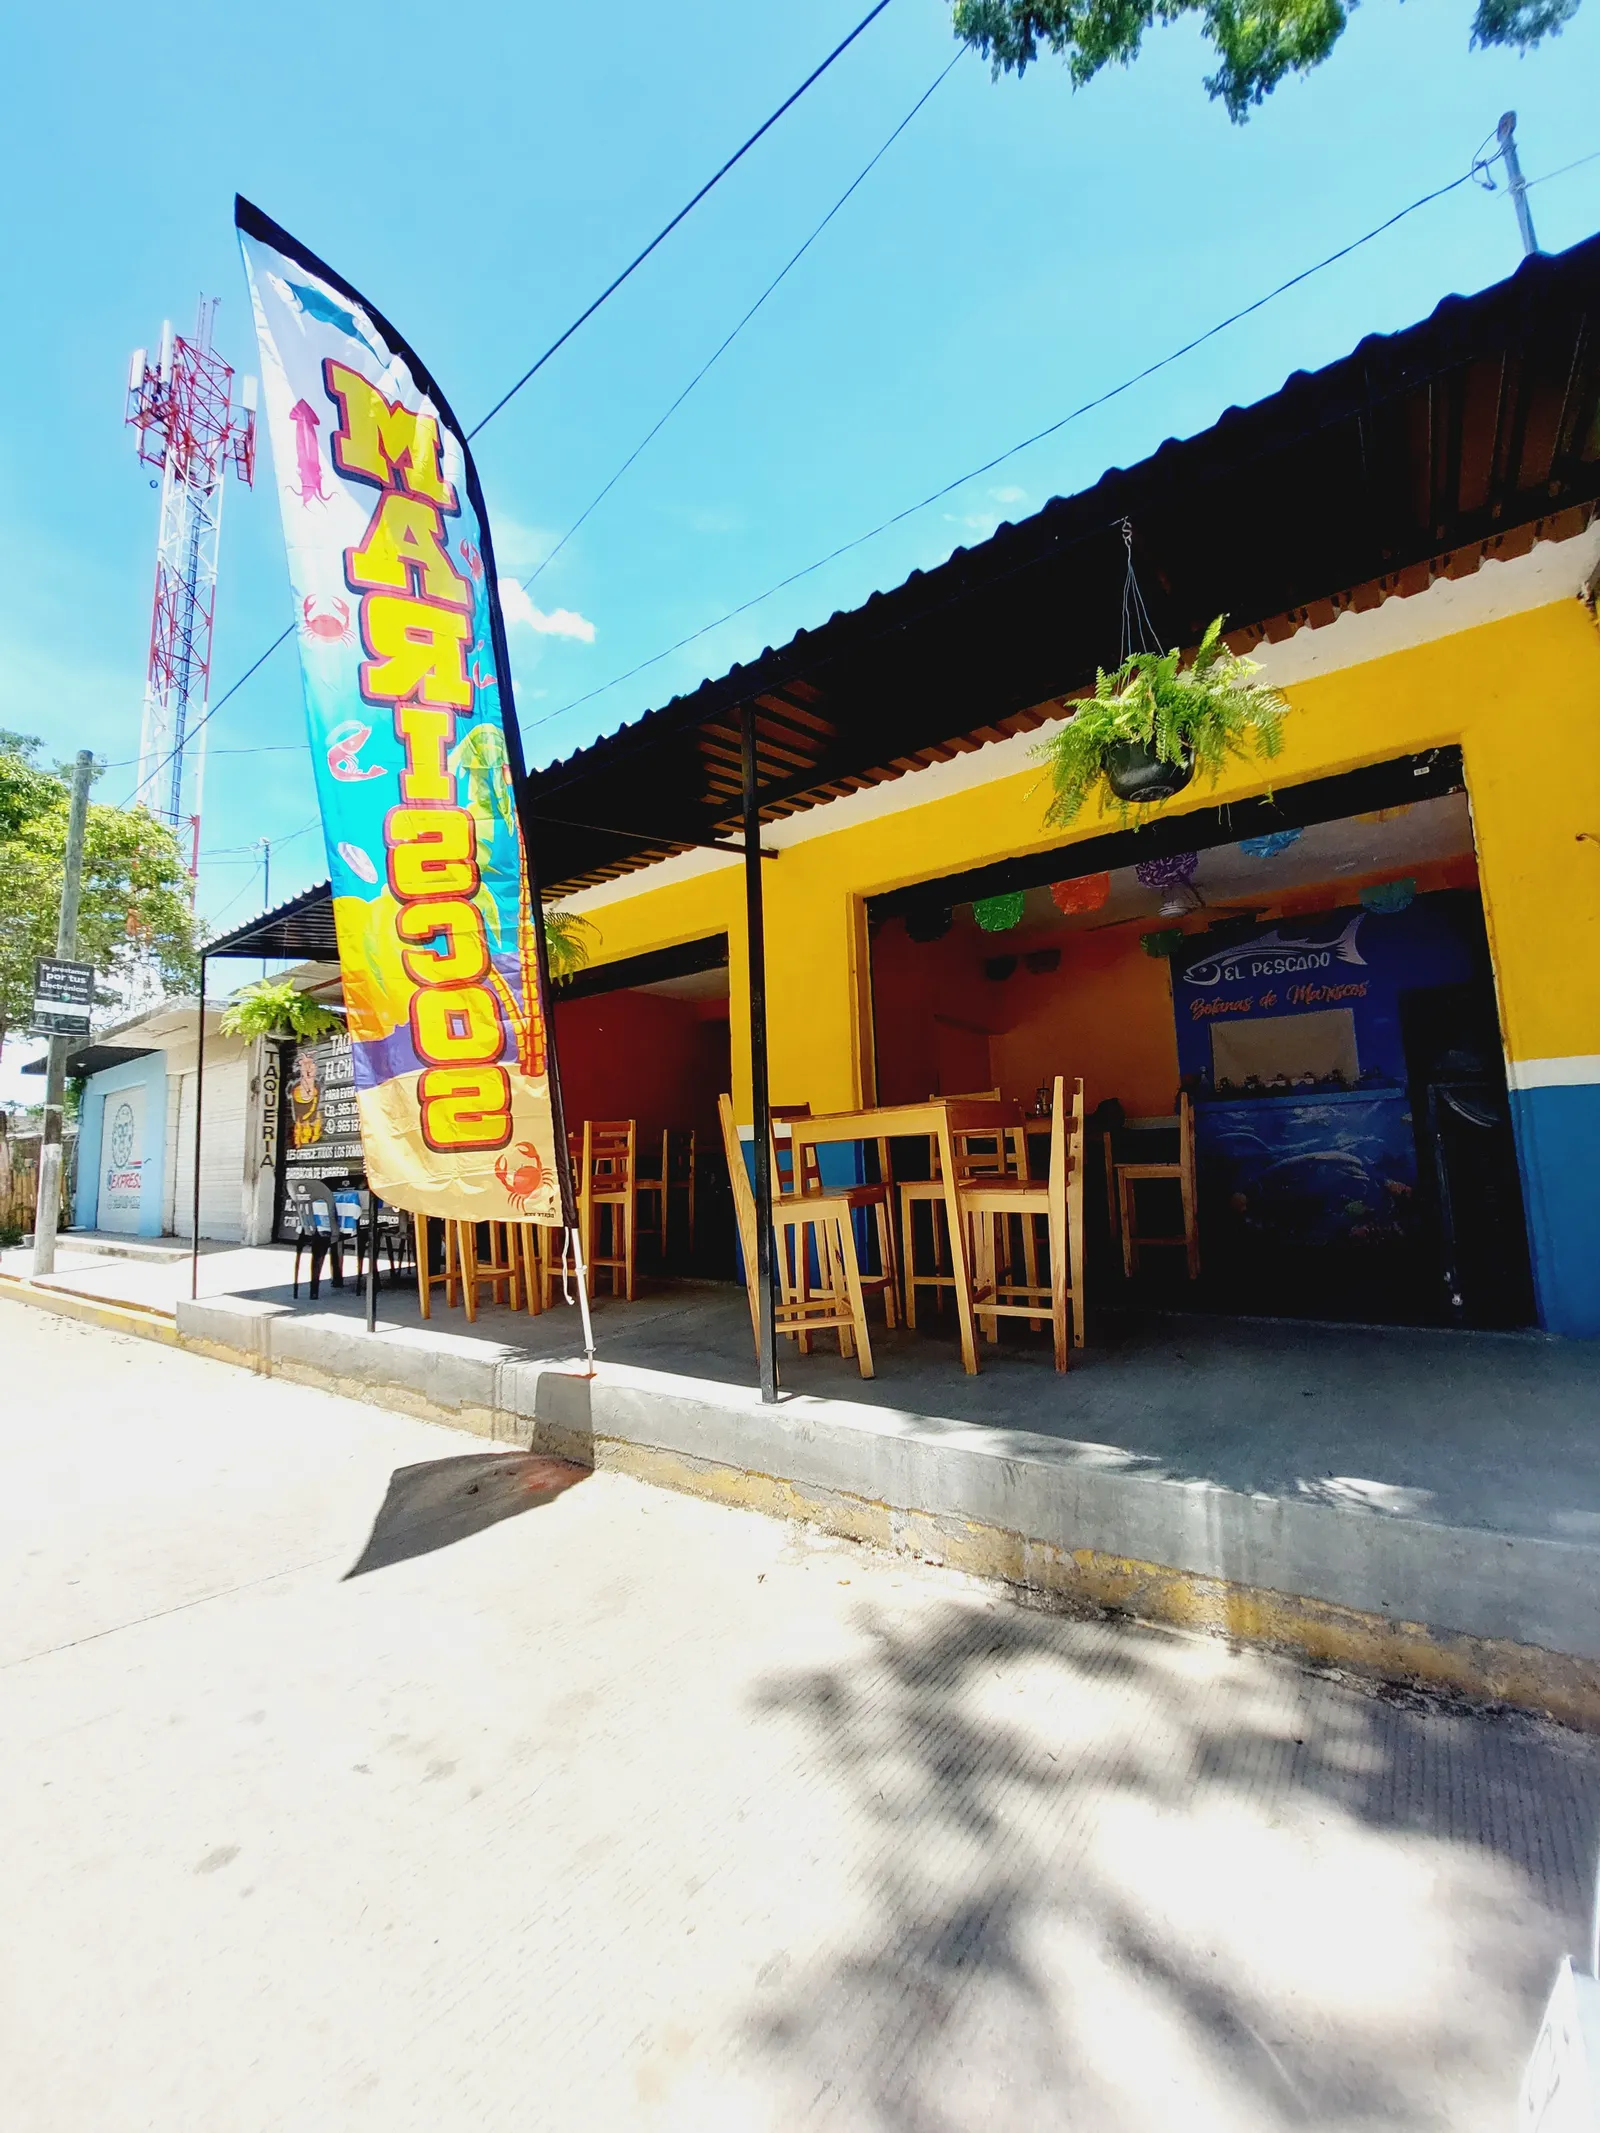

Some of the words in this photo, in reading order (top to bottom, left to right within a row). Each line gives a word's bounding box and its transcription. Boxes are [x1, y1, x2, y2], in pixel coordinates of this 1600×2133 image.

[46, 972, 66, 981] por
[68, 975, 87, 984] tus
[1224, 967, 1246, 981] EL
[1251, 951, 1331, 977] PESCADO
[1189, 995, 1255, 1020] Botanas
[1259, 989, 1278, 1009] de
[259, 1050, 279, 1168] TAQUERIA
